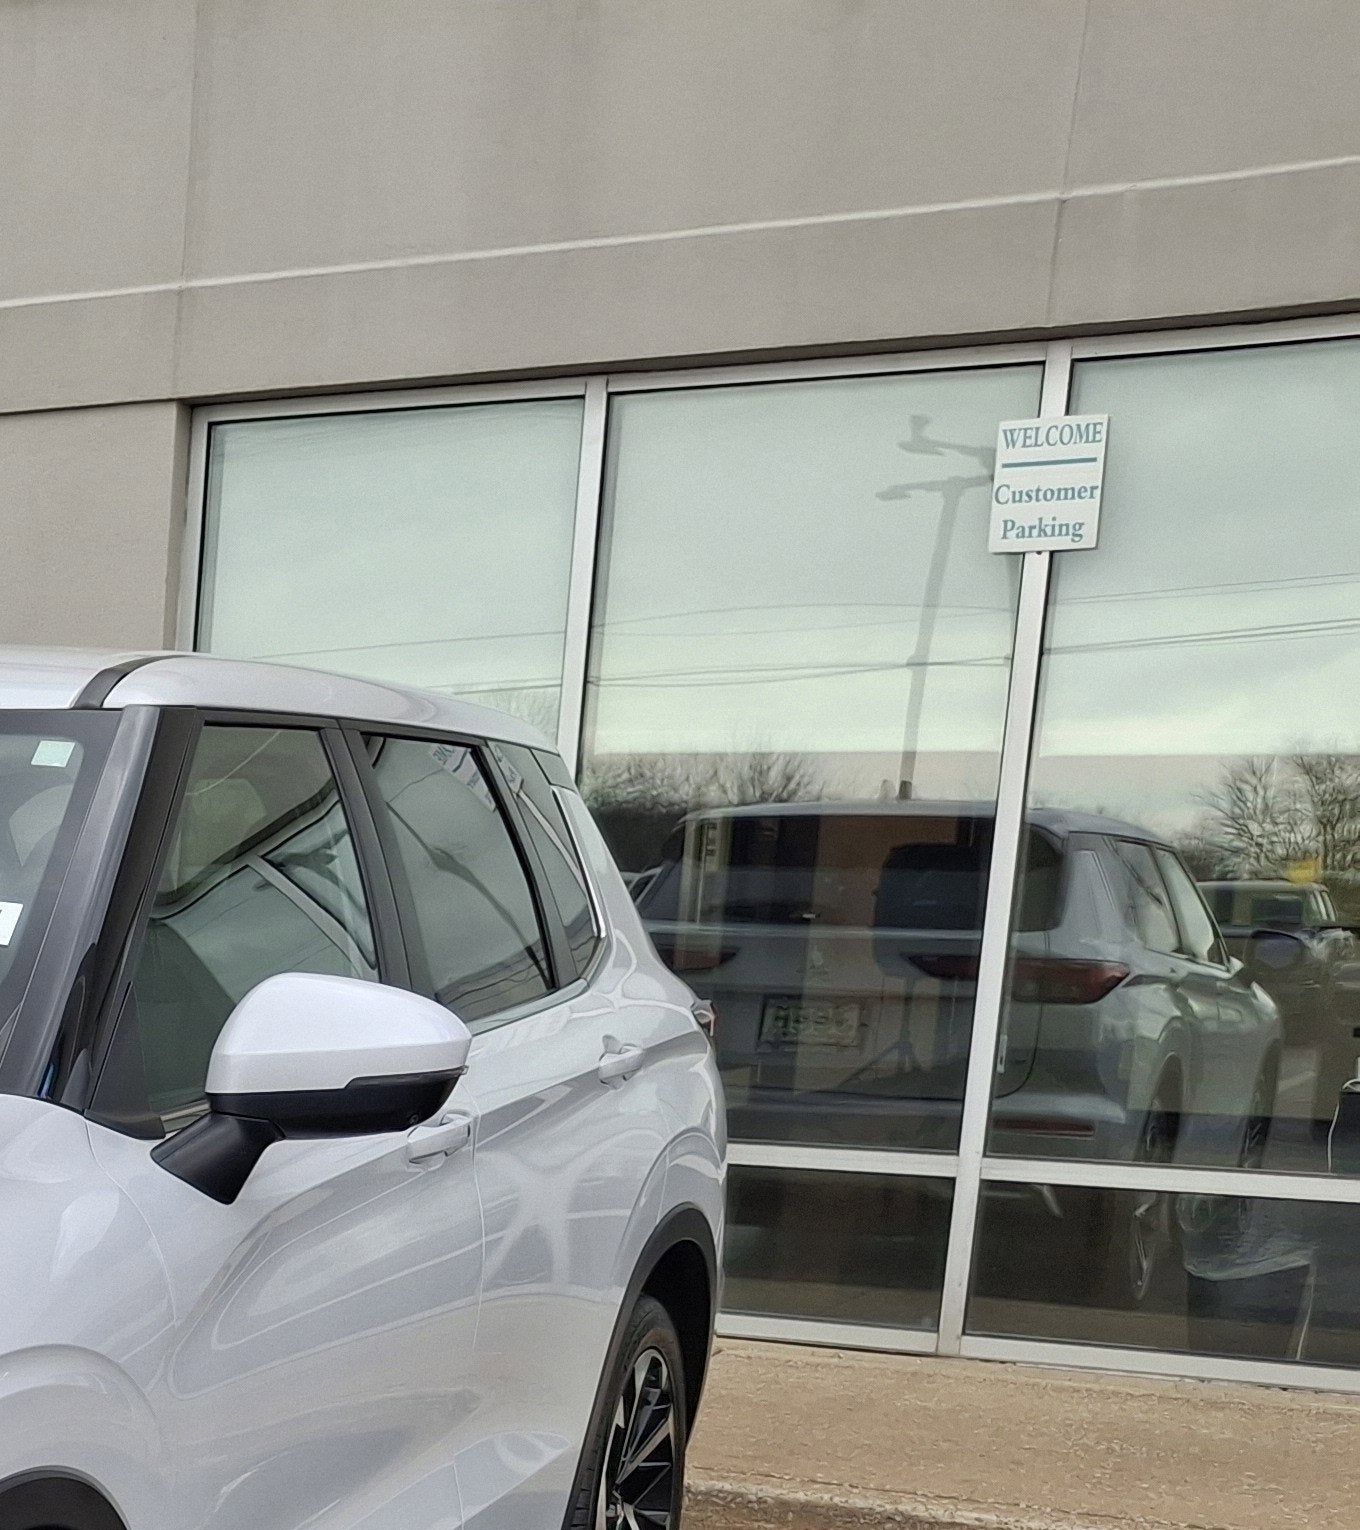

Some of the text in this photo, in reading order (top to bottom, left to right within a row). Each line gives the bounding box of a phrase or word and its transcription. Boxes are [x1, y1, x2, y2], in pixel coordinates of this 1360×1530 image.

[1002, 422, 1104, 449] WELCOME
[994, 484, 1099, 505] Customer
[1001, 516, 1085, 543] Parking
